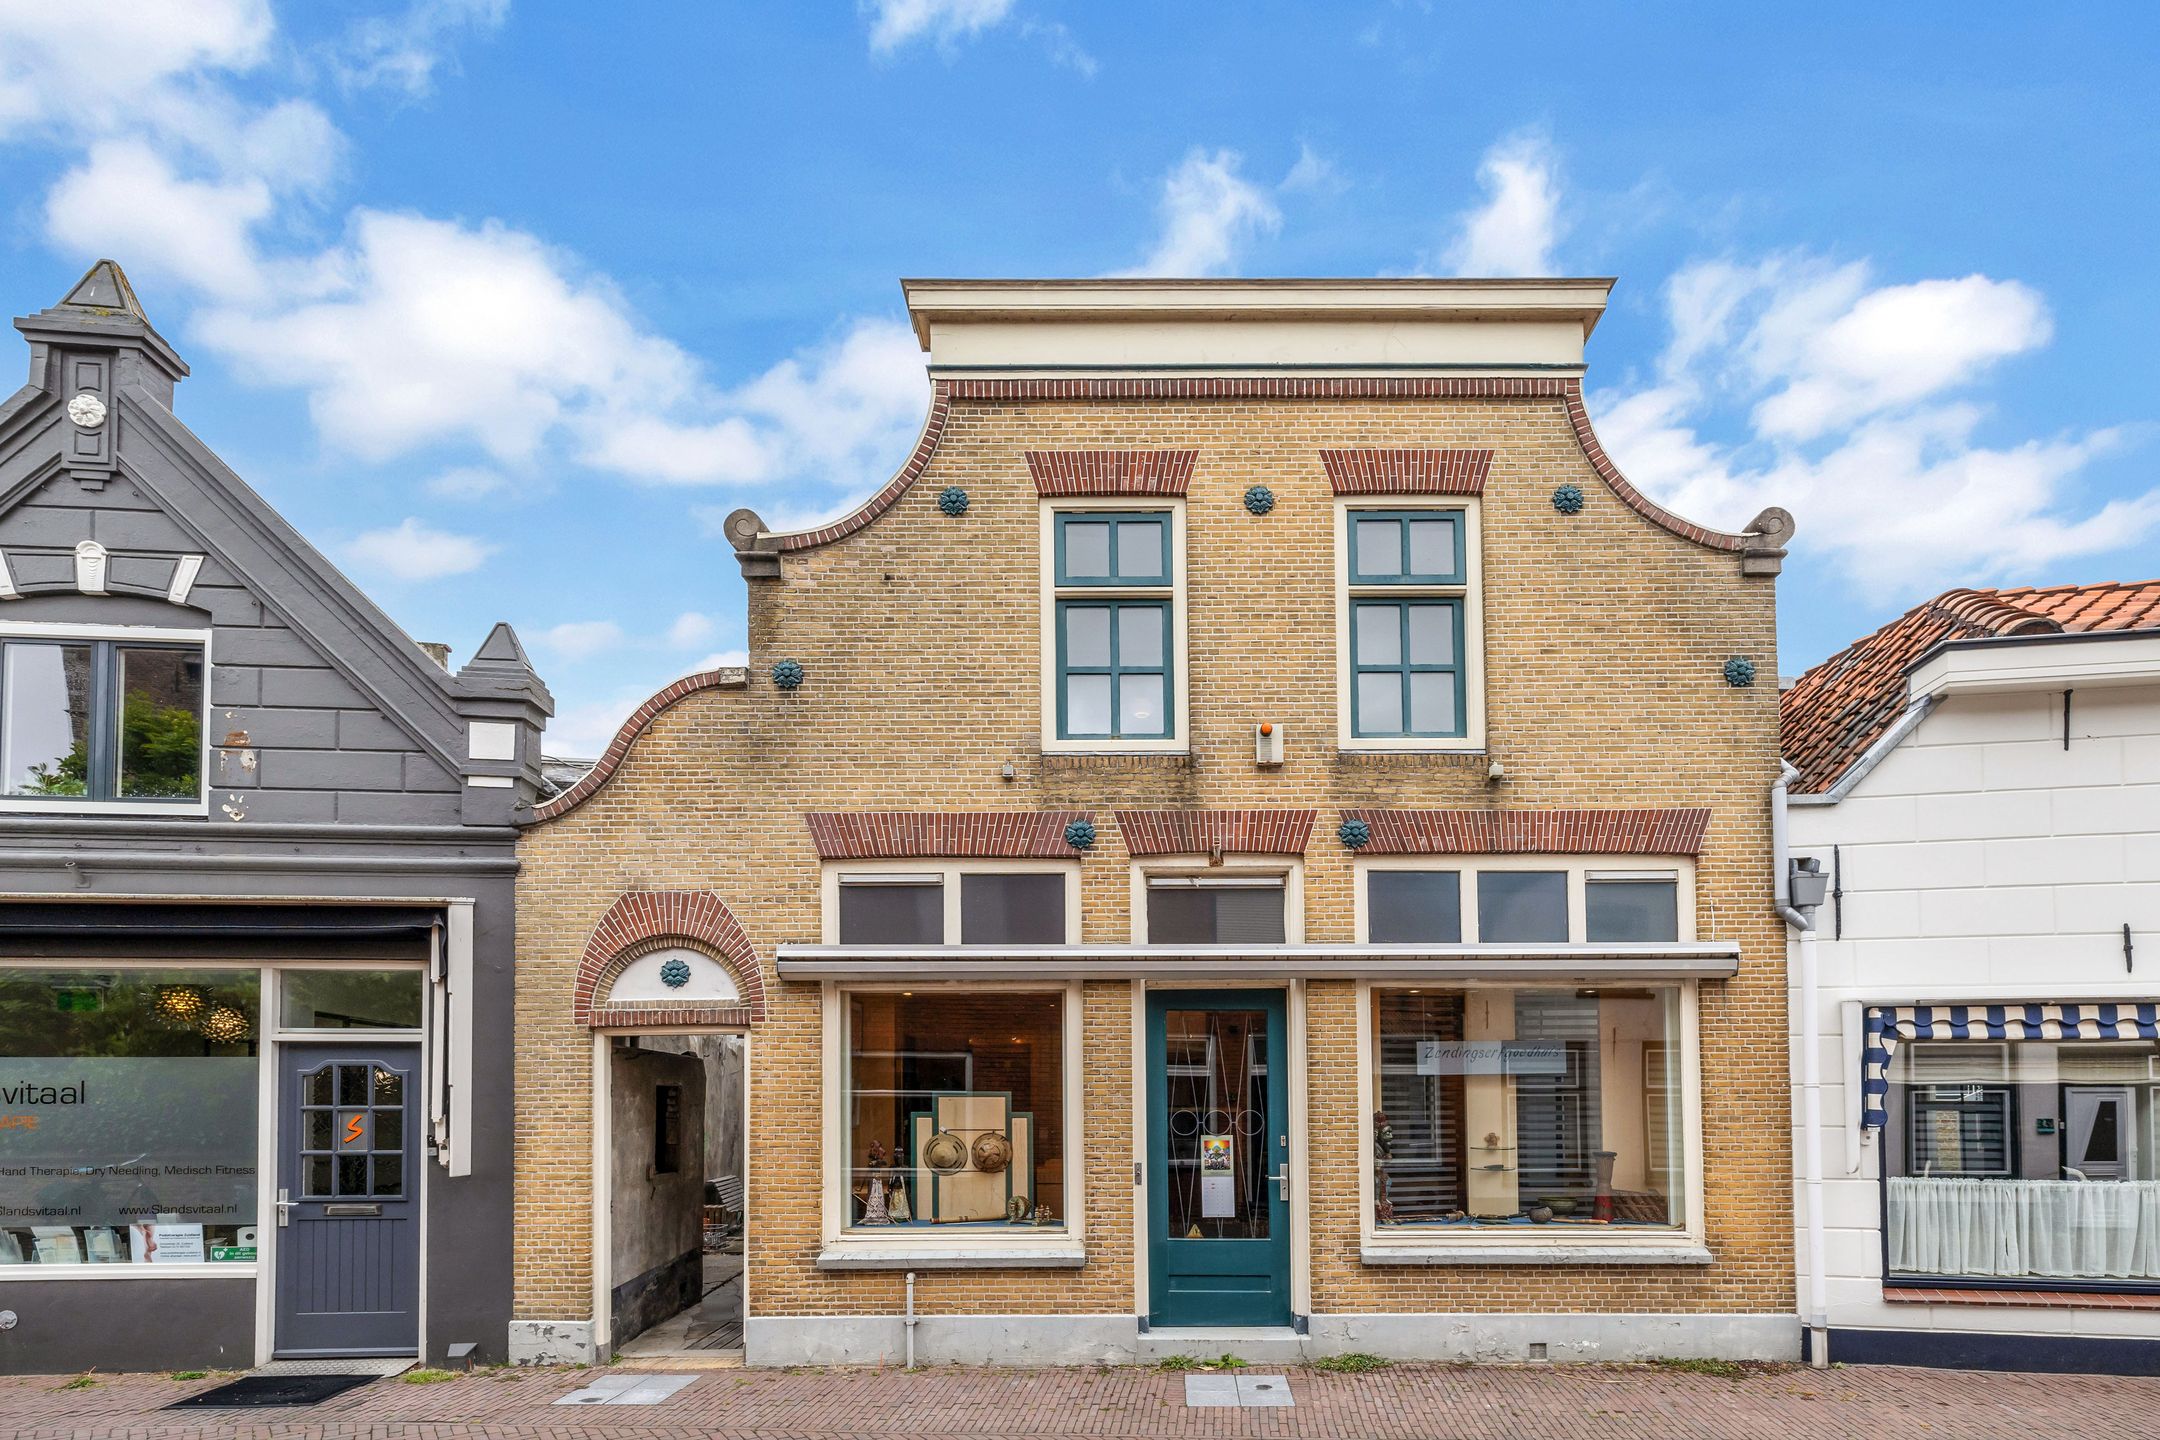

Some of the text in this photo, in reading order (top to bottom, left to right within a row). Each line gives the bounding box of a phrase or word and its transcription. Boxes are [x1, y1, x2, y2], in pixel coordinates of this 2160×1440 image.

[0, 1080, 85, 1105] vitaal
[30, 1166, 82, 1178] Therapie,
[86, 1166, 105, 1178] Dry
[109, 1166, 160, 1177] Needling,
[165, 1165, 212, 1175] Medisch
[216, 1165, 255, 1175] Fitness
[119, 1204, 237, 1215] www.Slandsvitaal.nl
